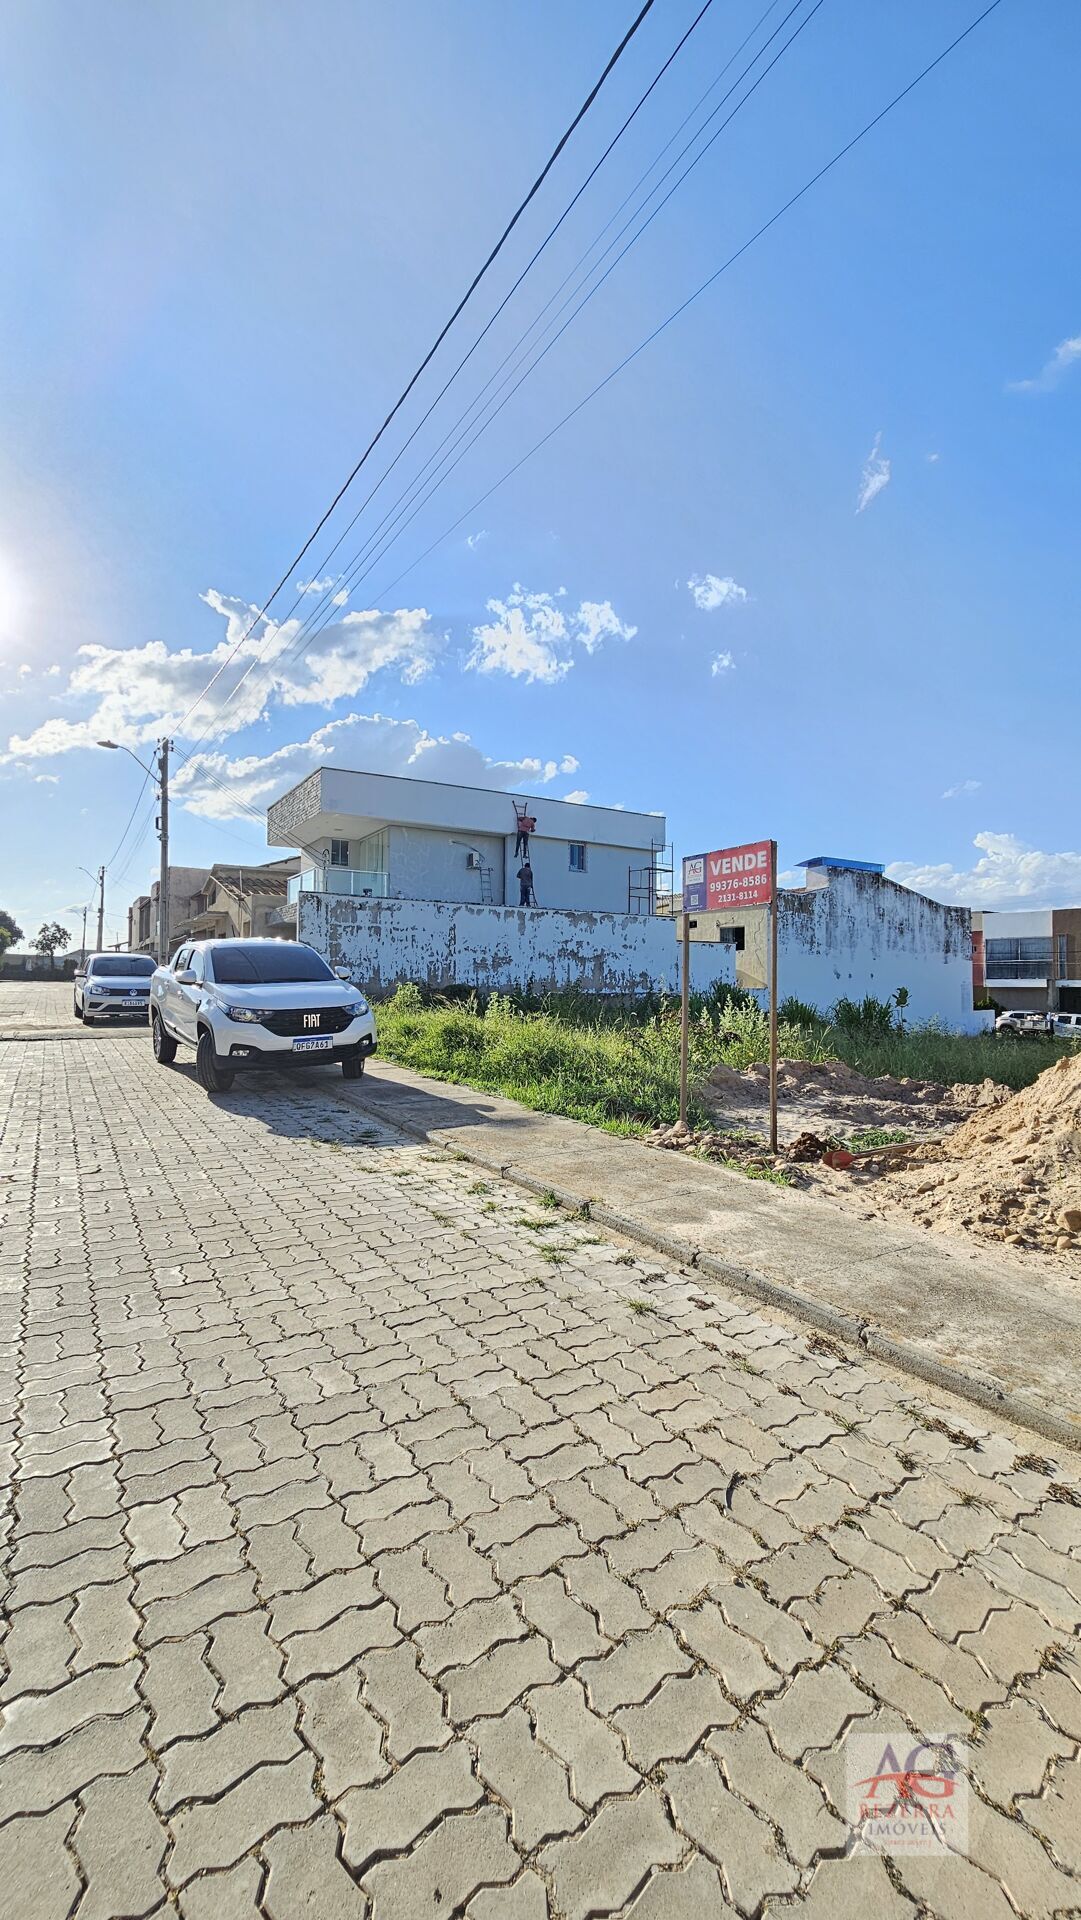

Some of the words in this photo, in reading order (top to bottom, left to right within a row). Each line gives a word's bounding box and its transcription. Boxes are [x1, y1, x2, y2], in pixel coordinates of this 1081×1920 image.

[688, 861, 702, 875] AG
[710, 850, 767, 876] VENDE
[710, 874, 767, 892] 99376-8586
[718, 890, 758, 903] 2131-8114
[303, 1013, 321, 1028] FIAT
